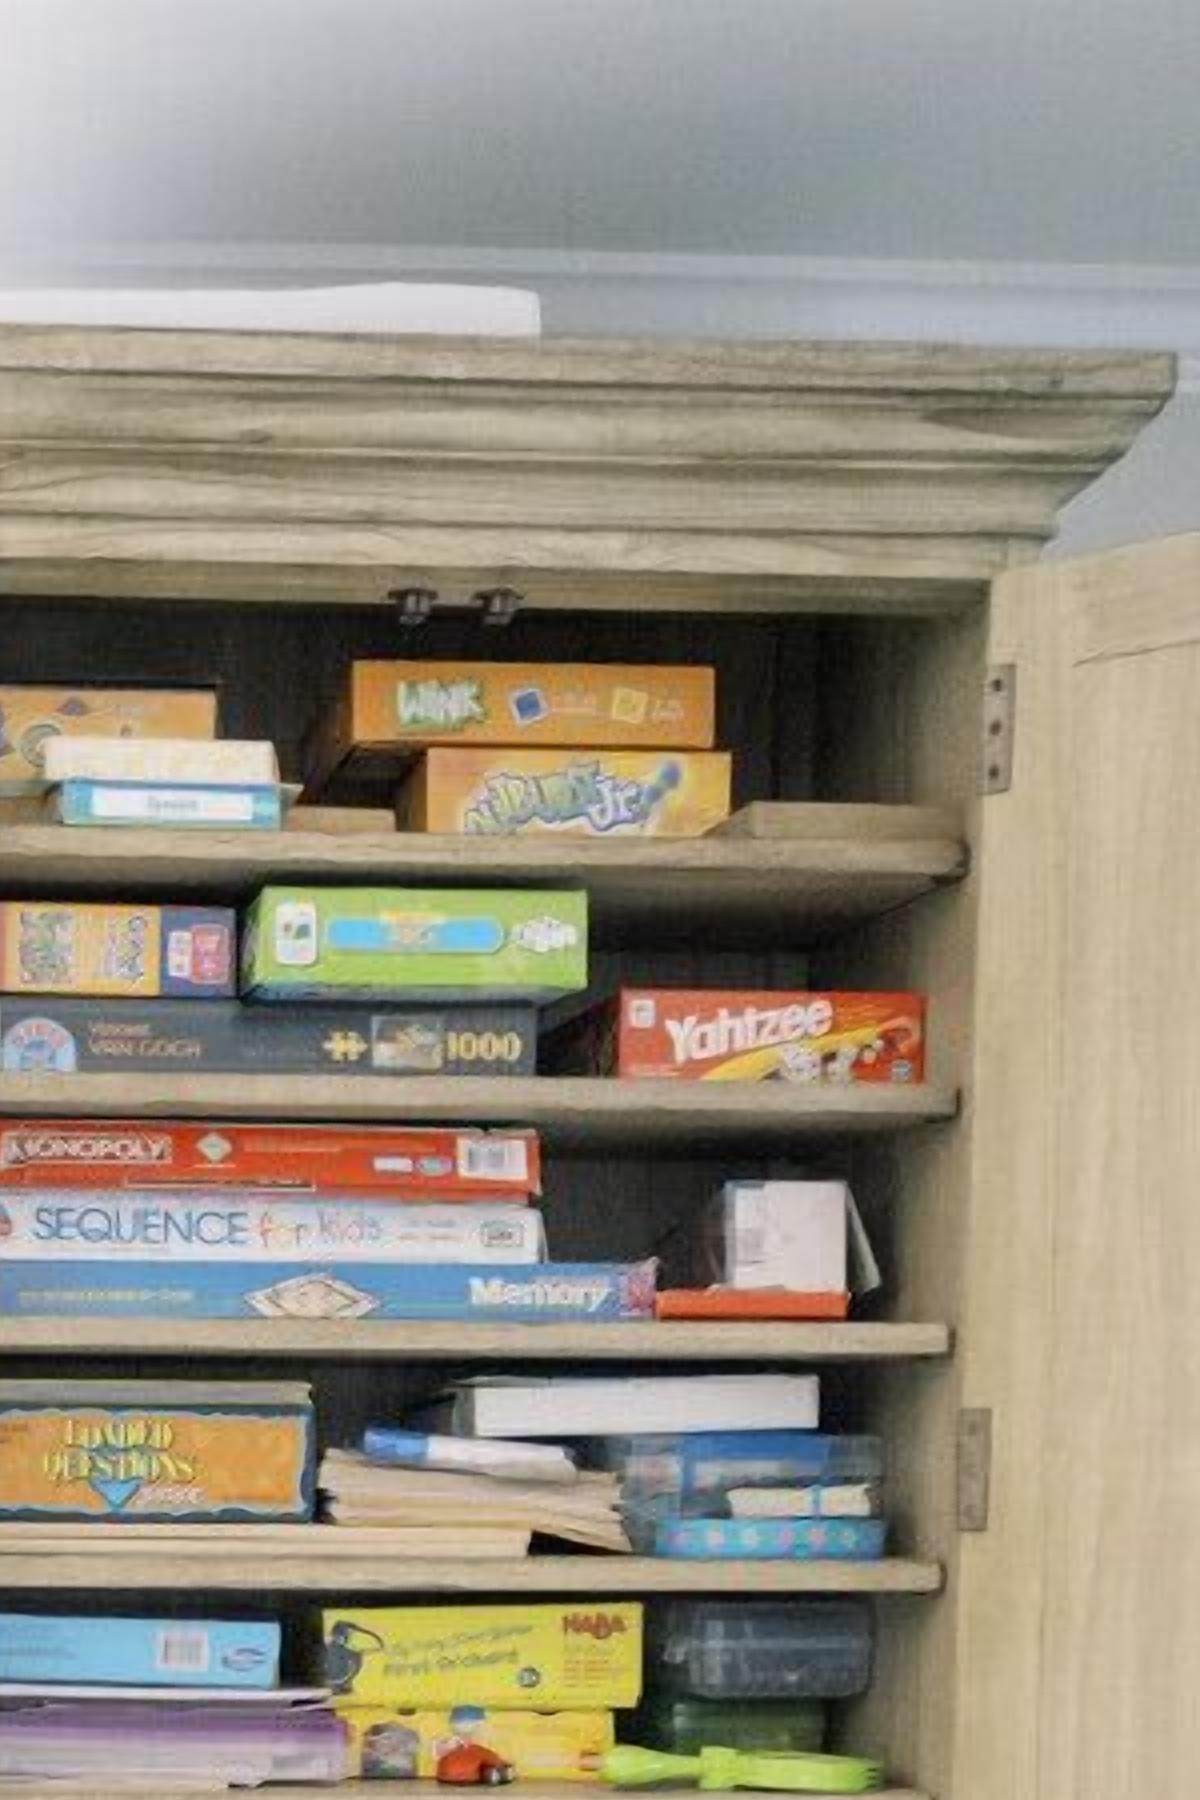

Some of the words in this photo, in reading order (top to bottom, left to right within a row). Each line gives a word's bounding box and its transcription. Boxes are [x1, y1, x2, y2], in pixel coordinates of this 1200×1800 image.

[447, 1031, 522, 1062] 1000
[665, 999, 834, 1067] Yahtzee
[33, 1206, 250, 1245] SEQUENCE
[468, 1276, 611, 1313] Memory
[562, 1613, 630, 1641] HABA
